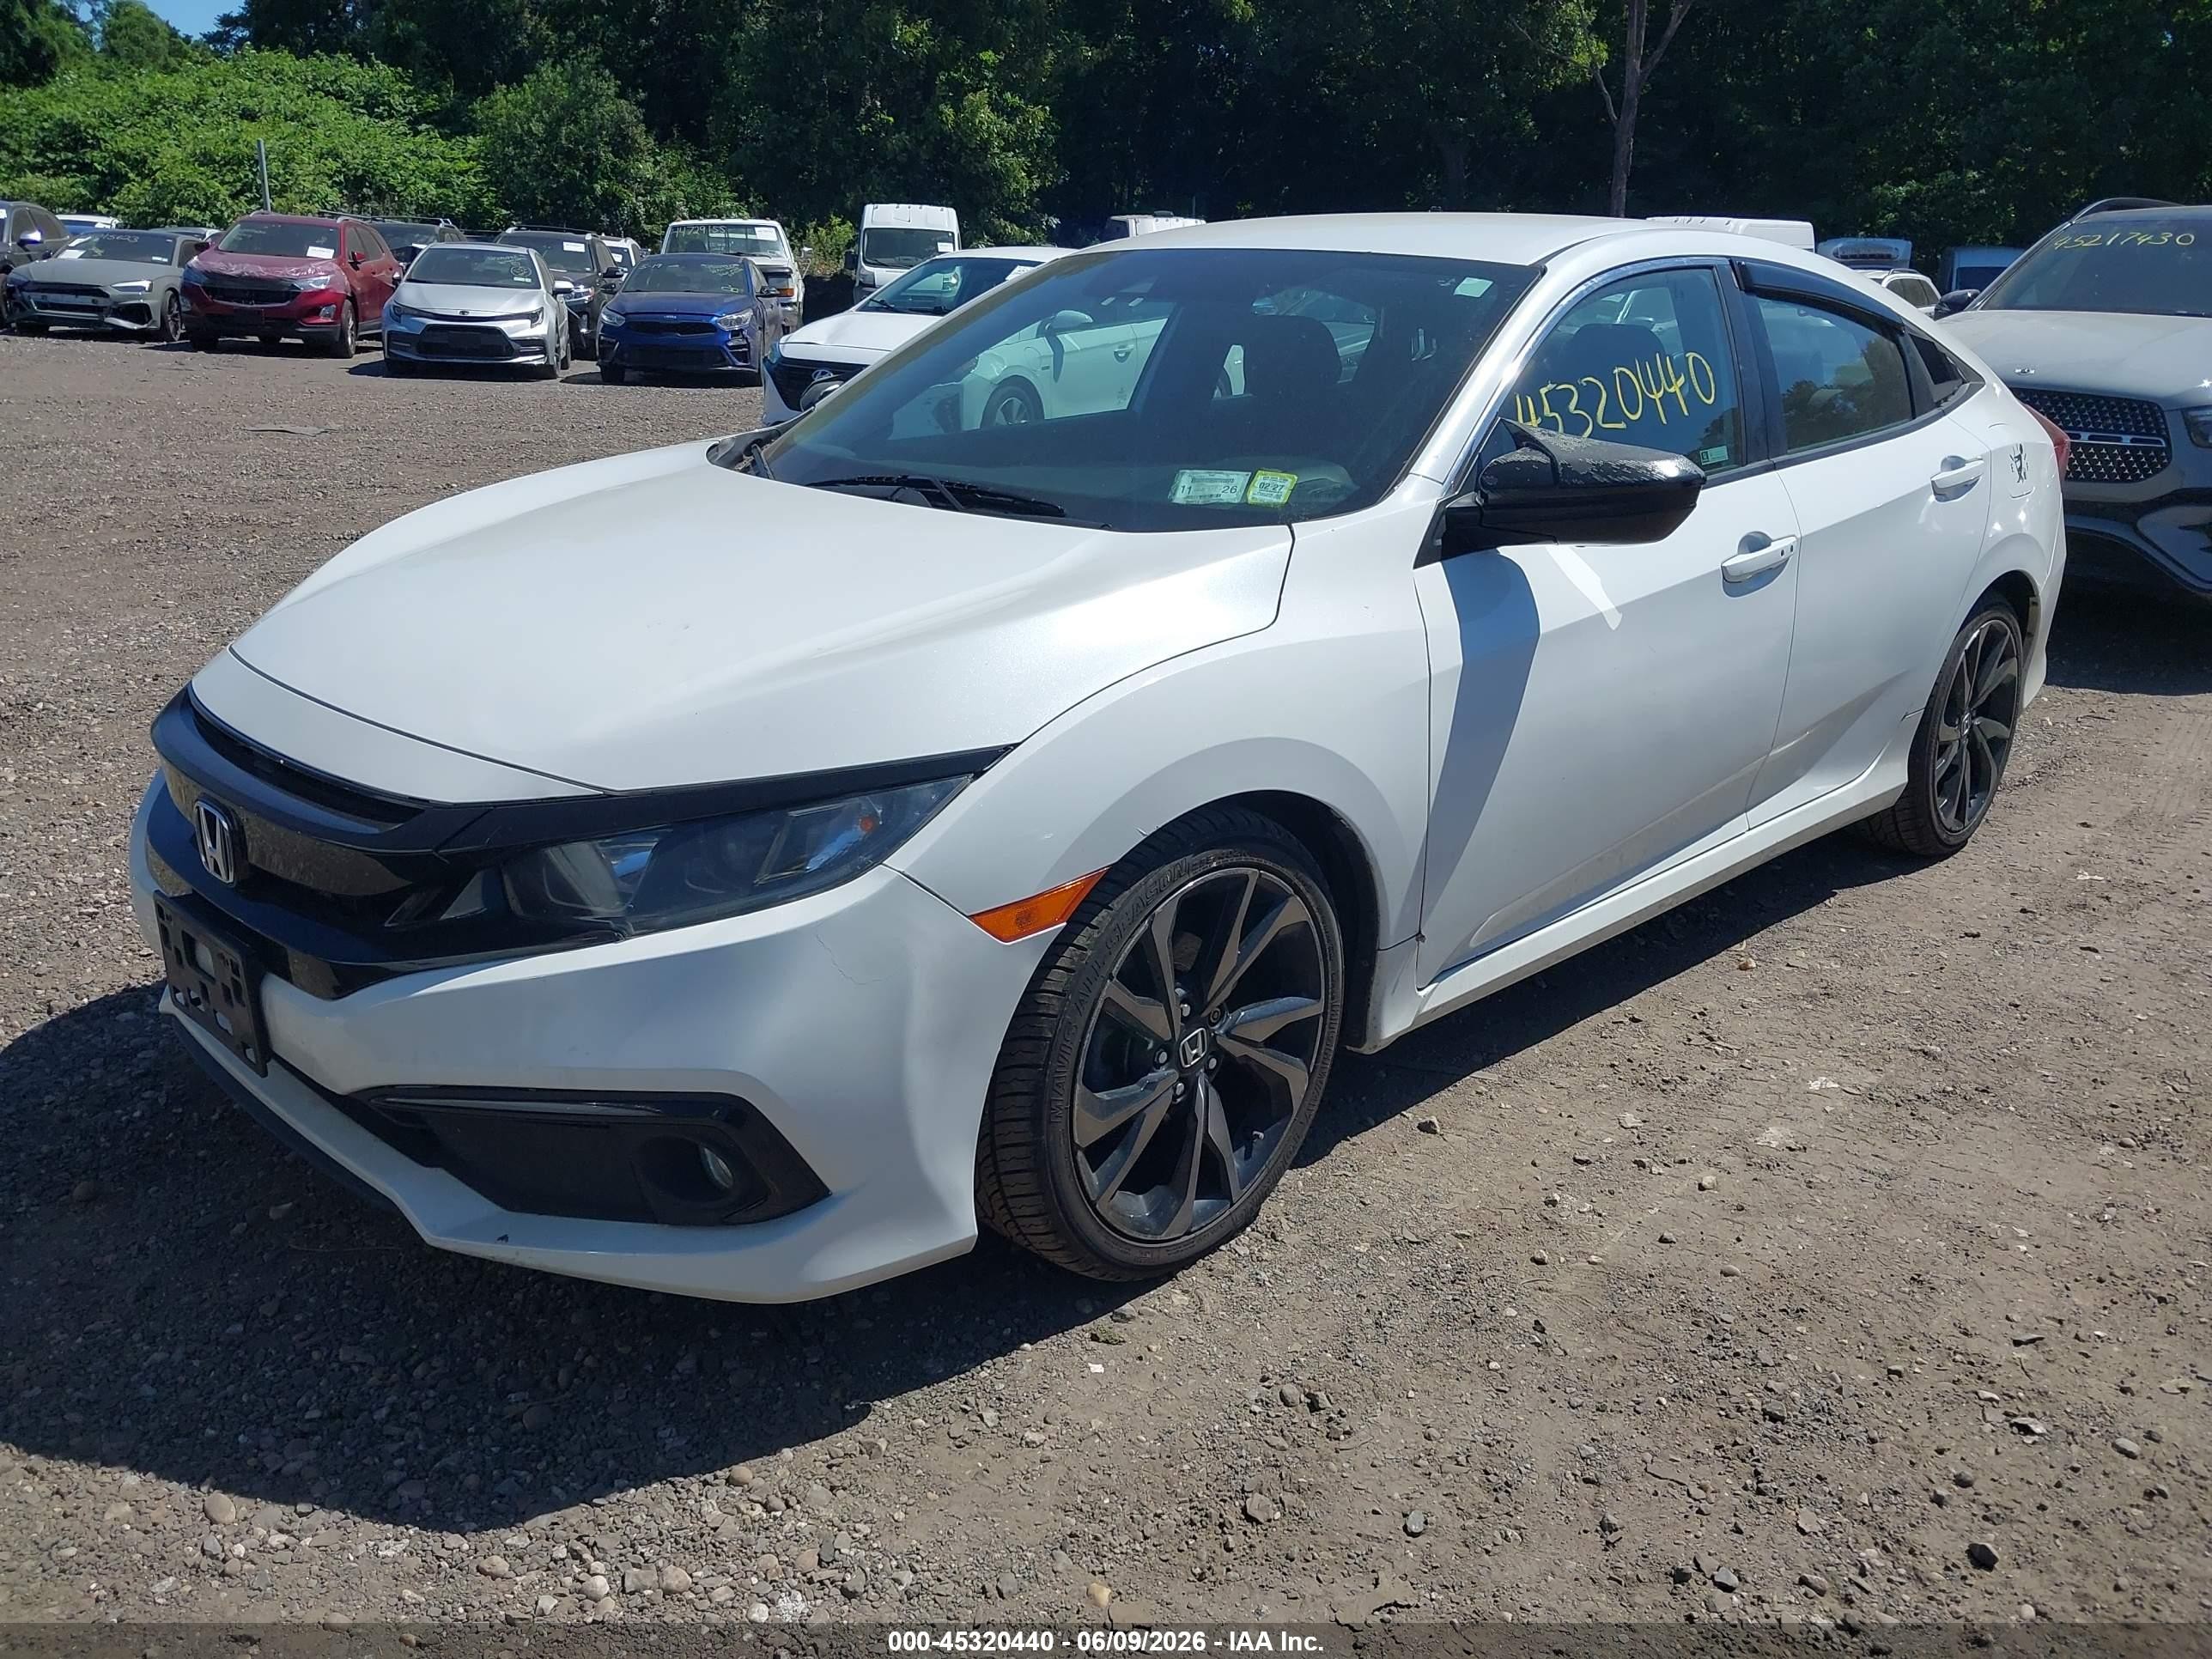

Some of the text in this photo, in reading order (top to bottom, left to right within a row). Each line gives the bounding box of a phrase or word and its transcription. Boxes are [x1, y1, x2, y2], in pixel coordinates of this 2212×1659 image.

[2053, 232, 2196, 251] 45217430
[1514, 352, 1716, 438] 45320440
[1181, 484, 1238, 495] 11 26
